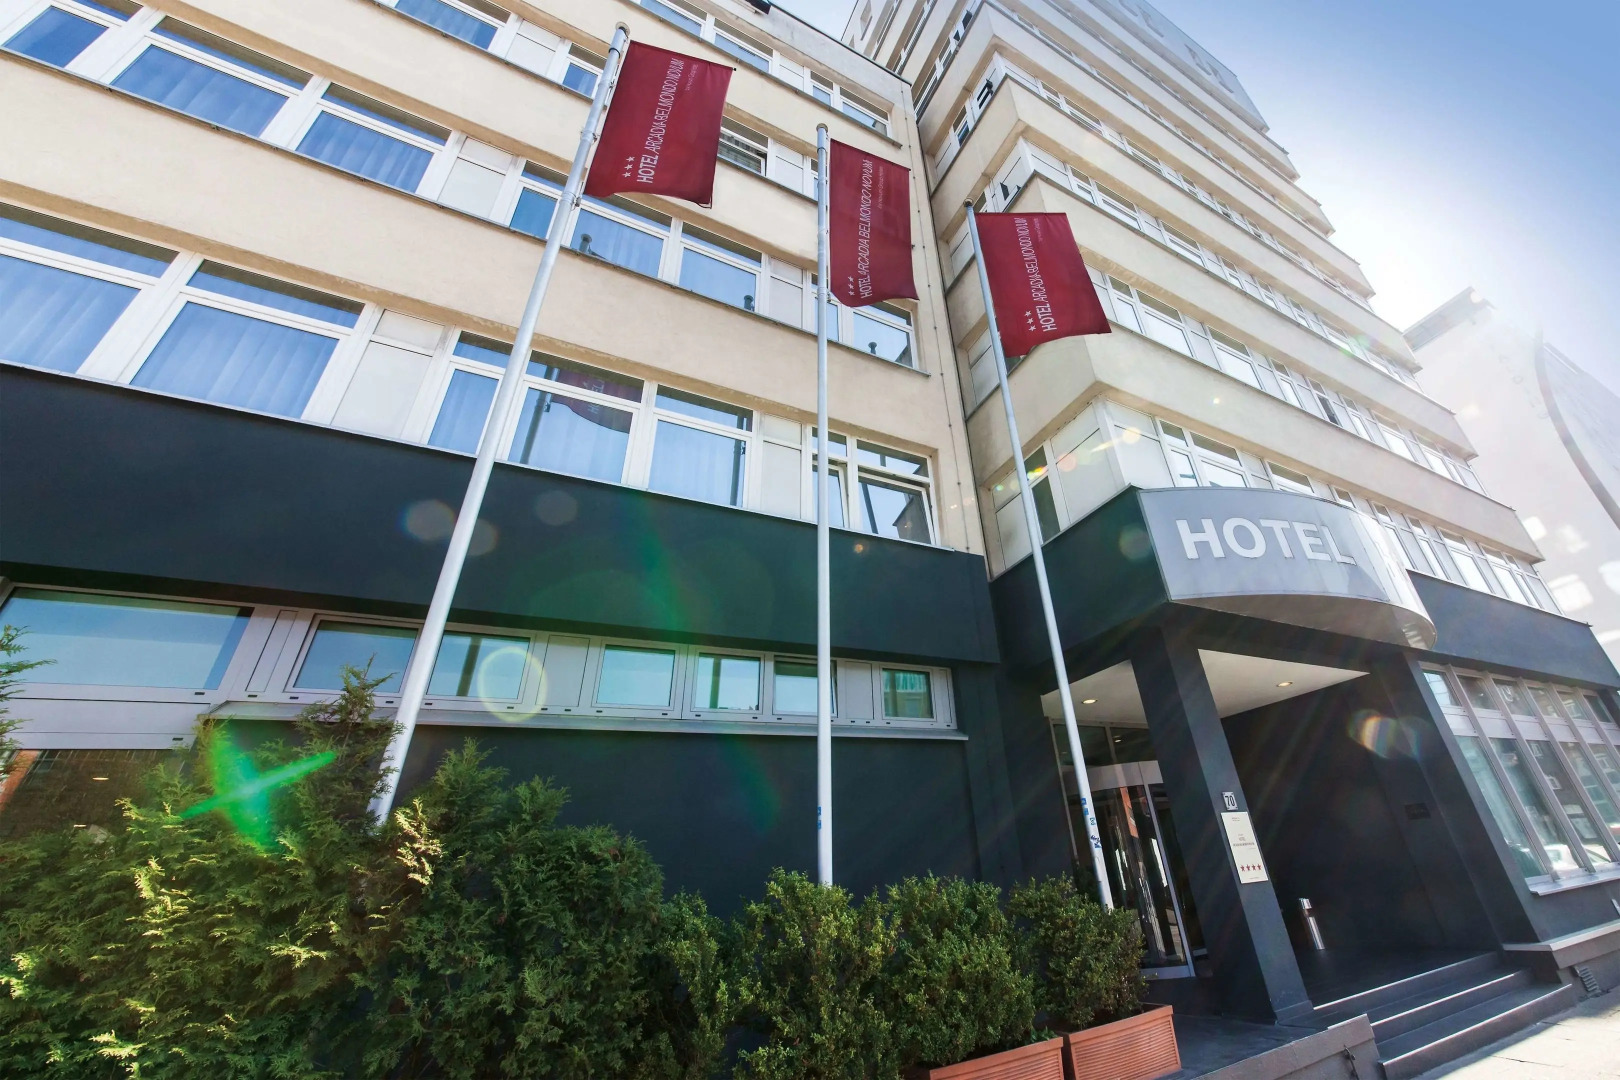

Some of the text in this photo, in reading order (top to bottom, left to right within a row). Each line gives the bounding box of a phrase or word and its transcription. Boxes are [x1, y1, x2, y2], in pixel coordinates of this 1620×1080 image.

[654, 79, 678, 122] BELMONDO
[644, 119, 668, 155] ARCADIA
[636, 154, 659, 184] HOTEL
[857, 159, 873, 299] HOTEL ARCADIA BELMONDO NOVUM
[1018, 236, 1040, 274] BELMONDO
[1028, 270, 1049, 303] ARCADIA
[1035, 303, 1057, 332] HOTEL
[1175, 516, 1357, 566] HOTEL
[1225, 795, 1236, 807] 70
